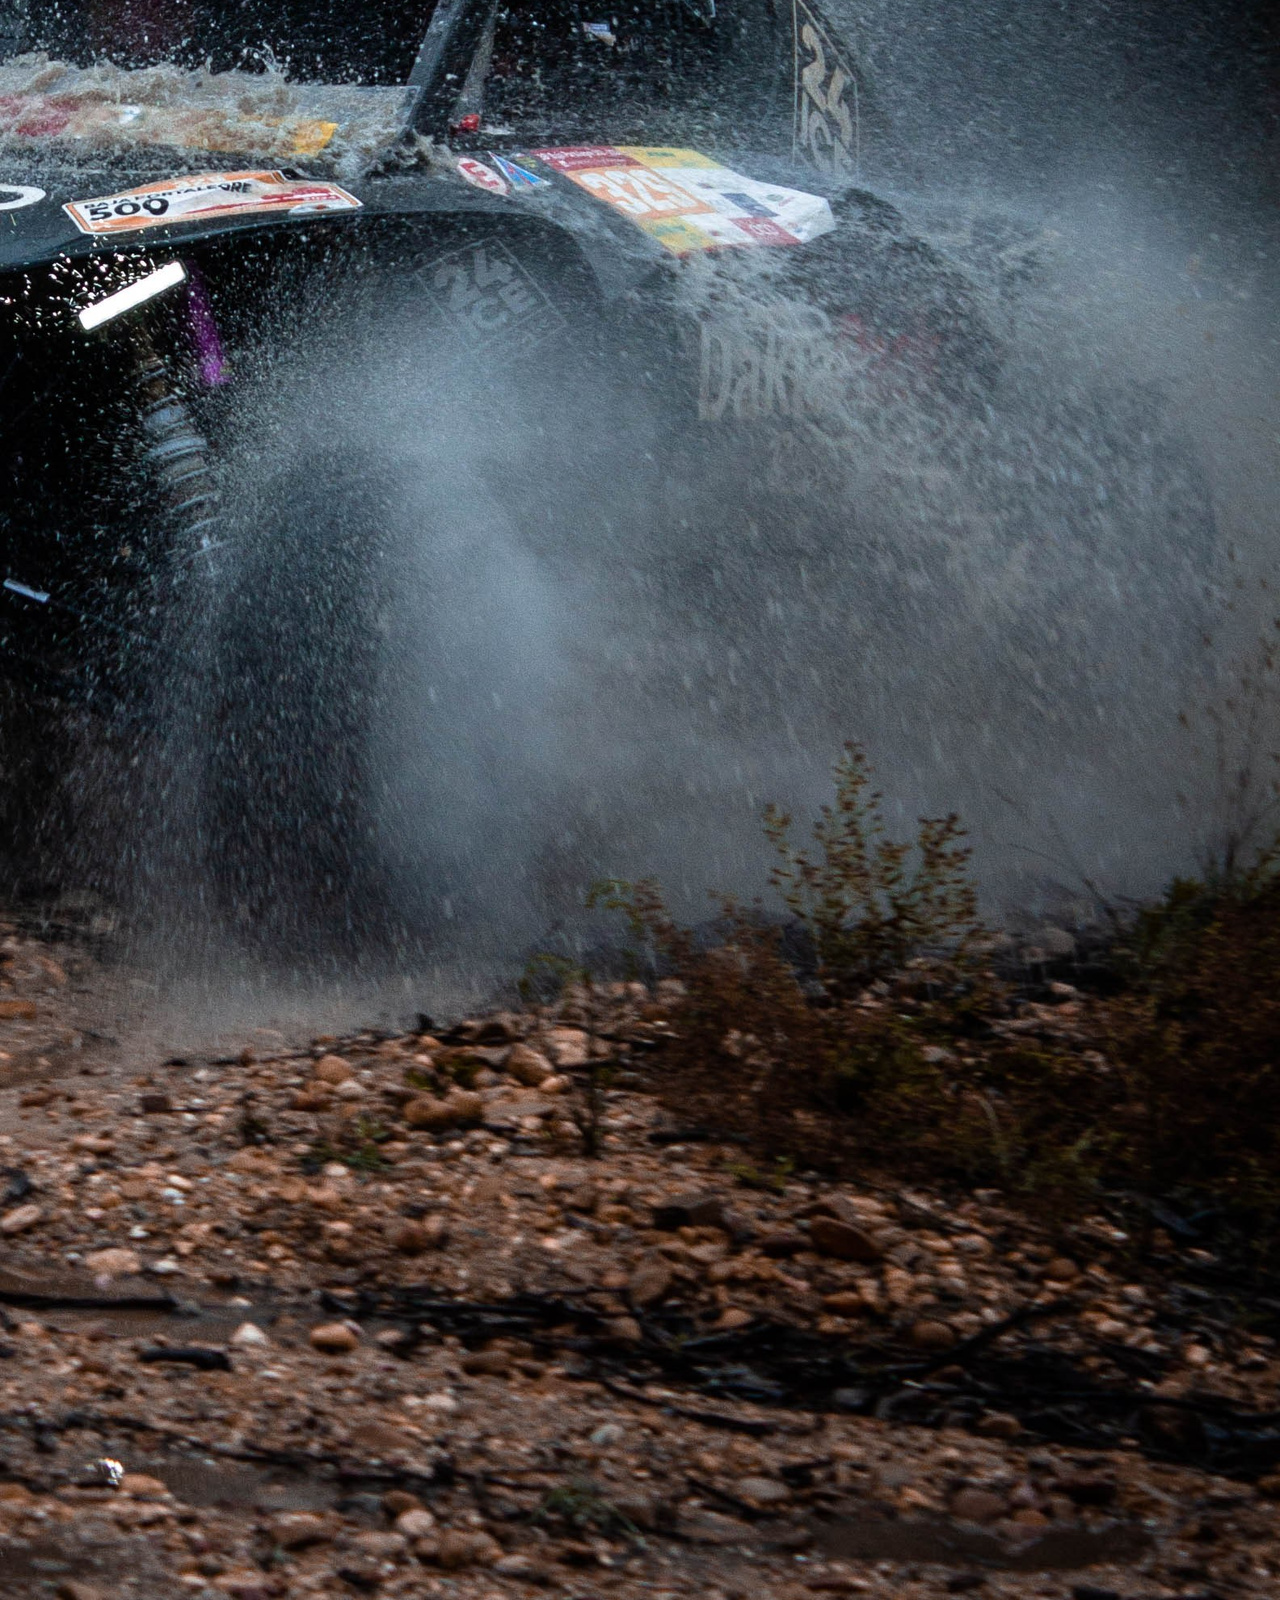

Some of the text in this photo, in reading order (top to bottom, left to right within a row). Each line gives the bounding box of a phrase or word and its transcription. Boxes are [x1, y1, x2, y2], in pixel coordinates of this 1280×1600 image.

[89, 197, 169, 221] 500
[579, 169, 700, 215] 329
[433, 248, 516, 314] 24
